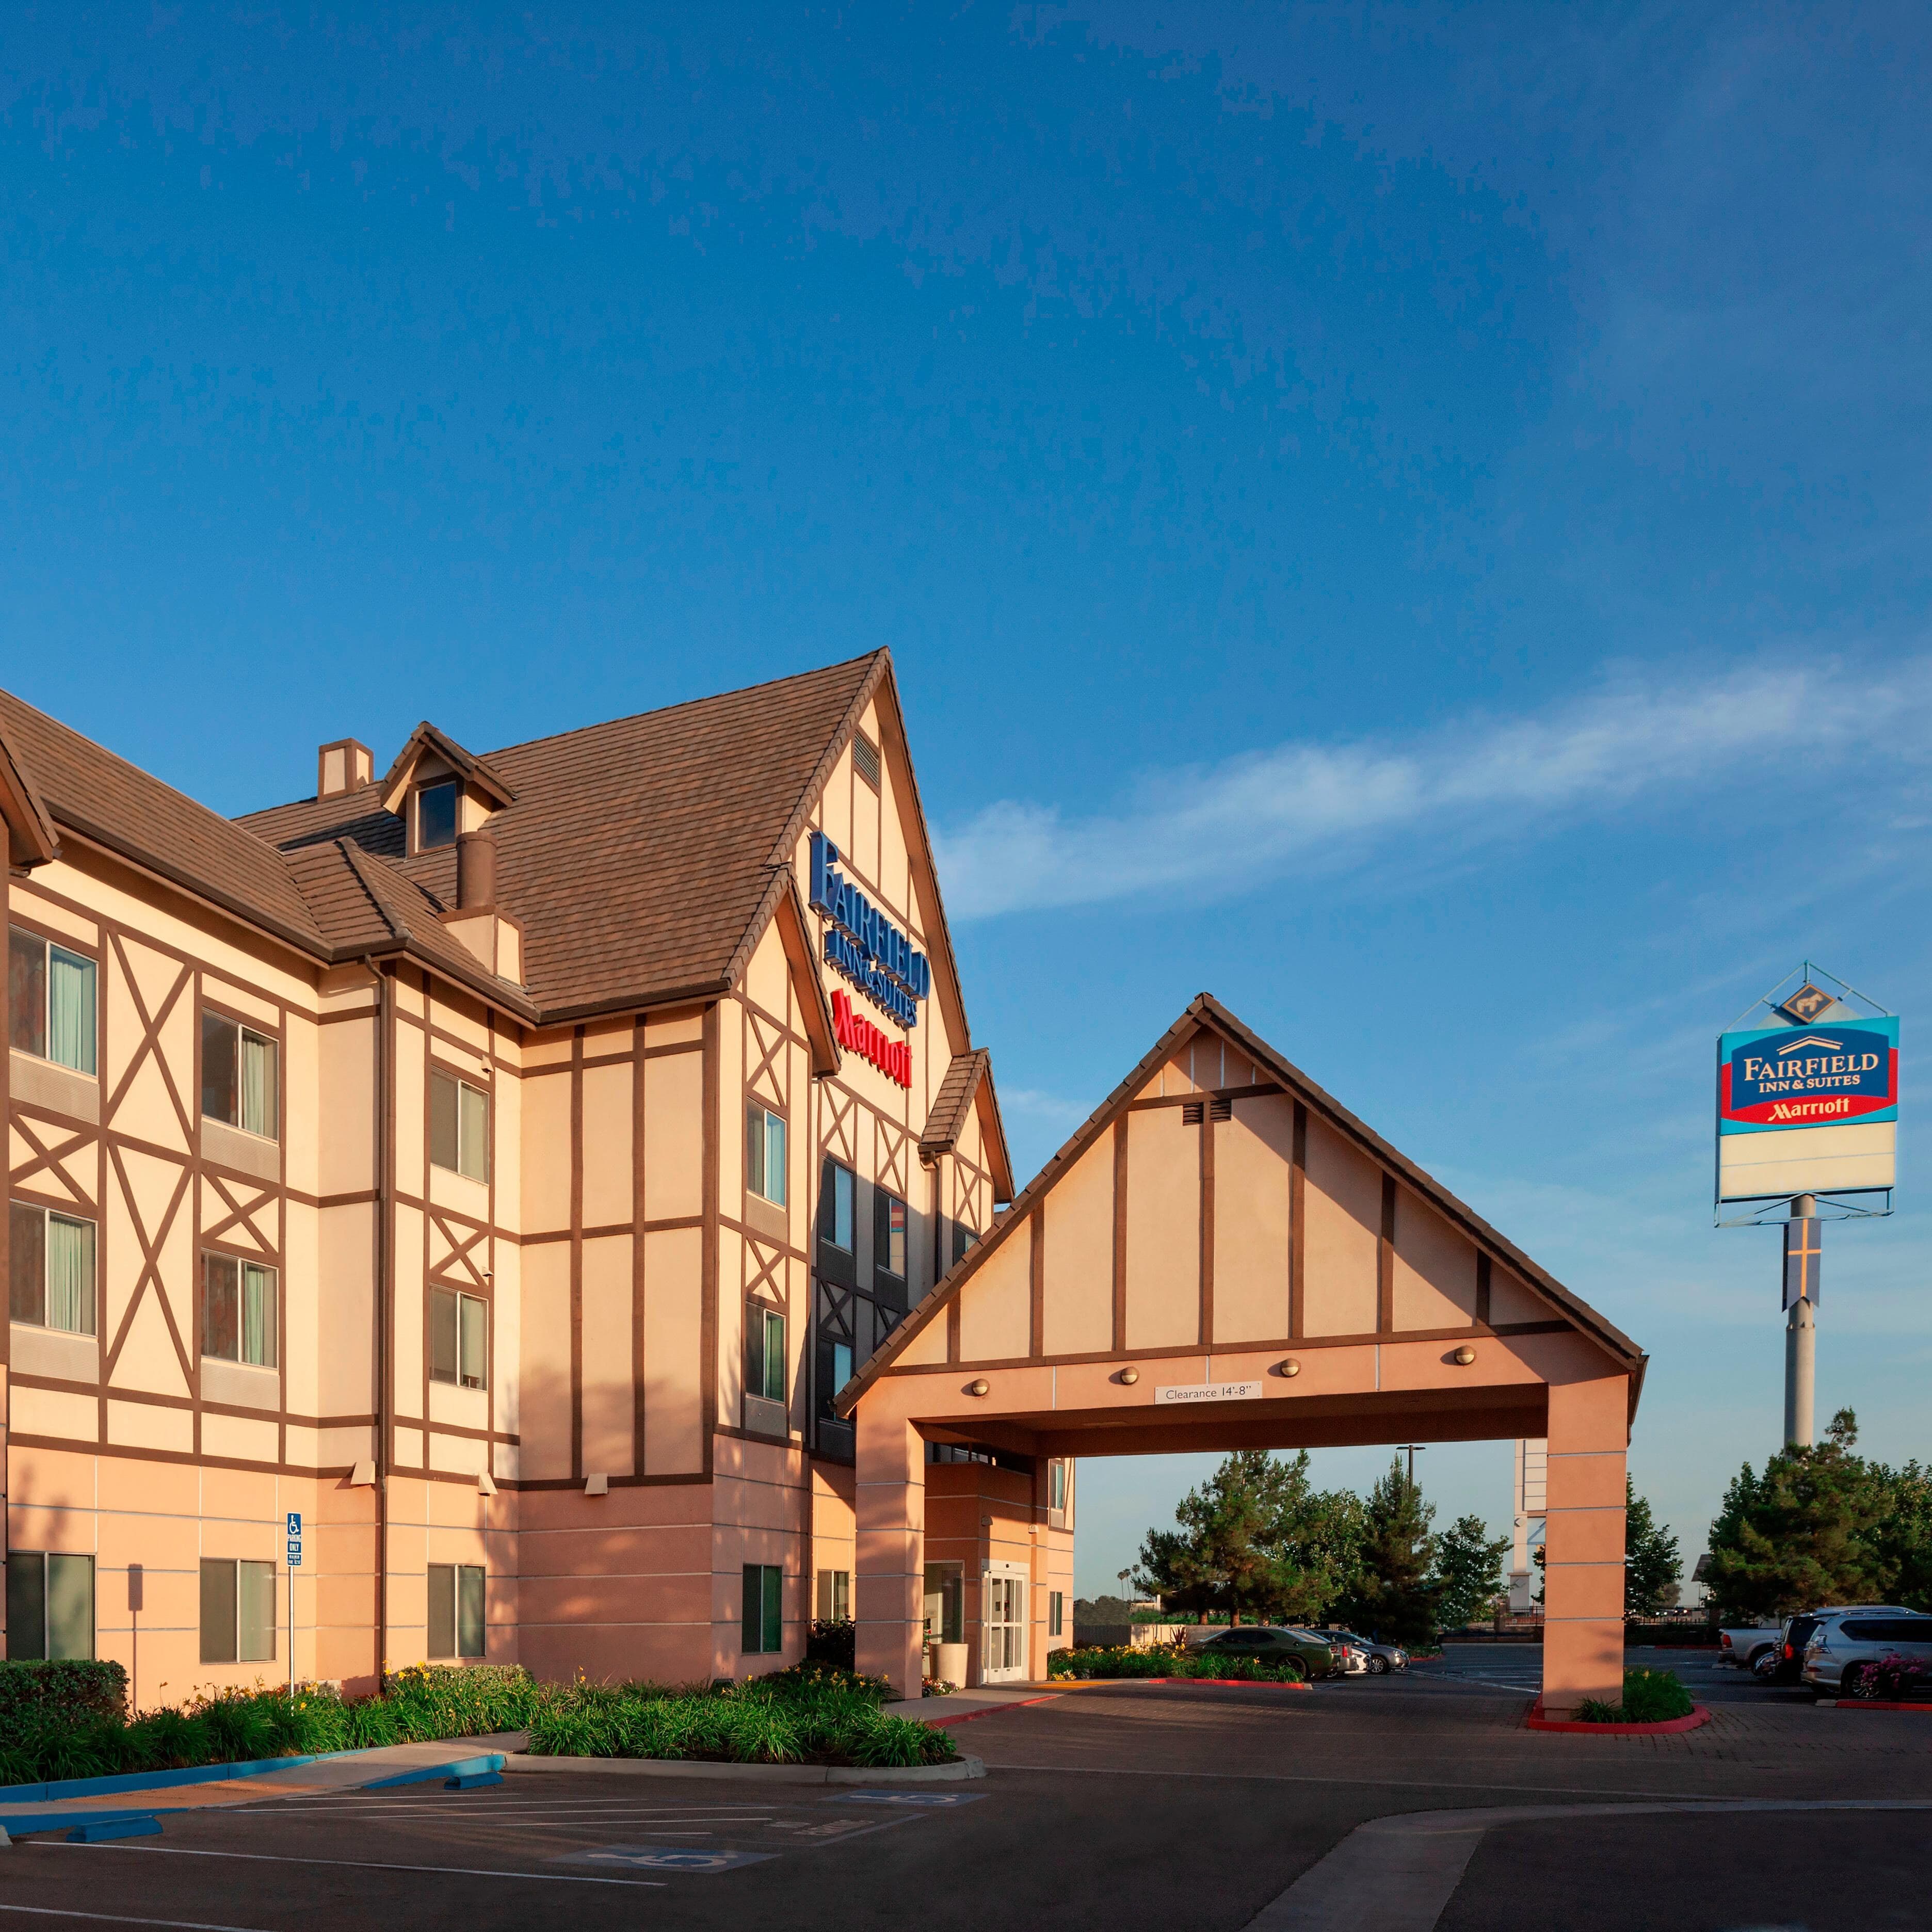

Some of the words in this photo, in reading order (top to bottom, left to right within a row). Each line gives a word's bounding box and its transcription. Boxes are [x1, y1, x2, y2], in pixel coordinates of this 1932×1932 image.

[809, 831, 931, 1001] FAIRFIELD
[825, 928, 863, 983] INN
[870, 970, 917, 1028] SUITES
[830, 988, 912, 1088] Marriott
[1744, 1053, 1879, 1081] FAIRFIELD
[1759, 1081, 1791, 1093] INN
[1792, 1079, 1805, 1089] &
[1806, 1074, 1861, 1089] SUITES
[1767, 1098, 1850, 1121] Marriott
[1166, 1390, 1217, 1399] Clearance
[289, 1543, 299, 1551] ONLY
